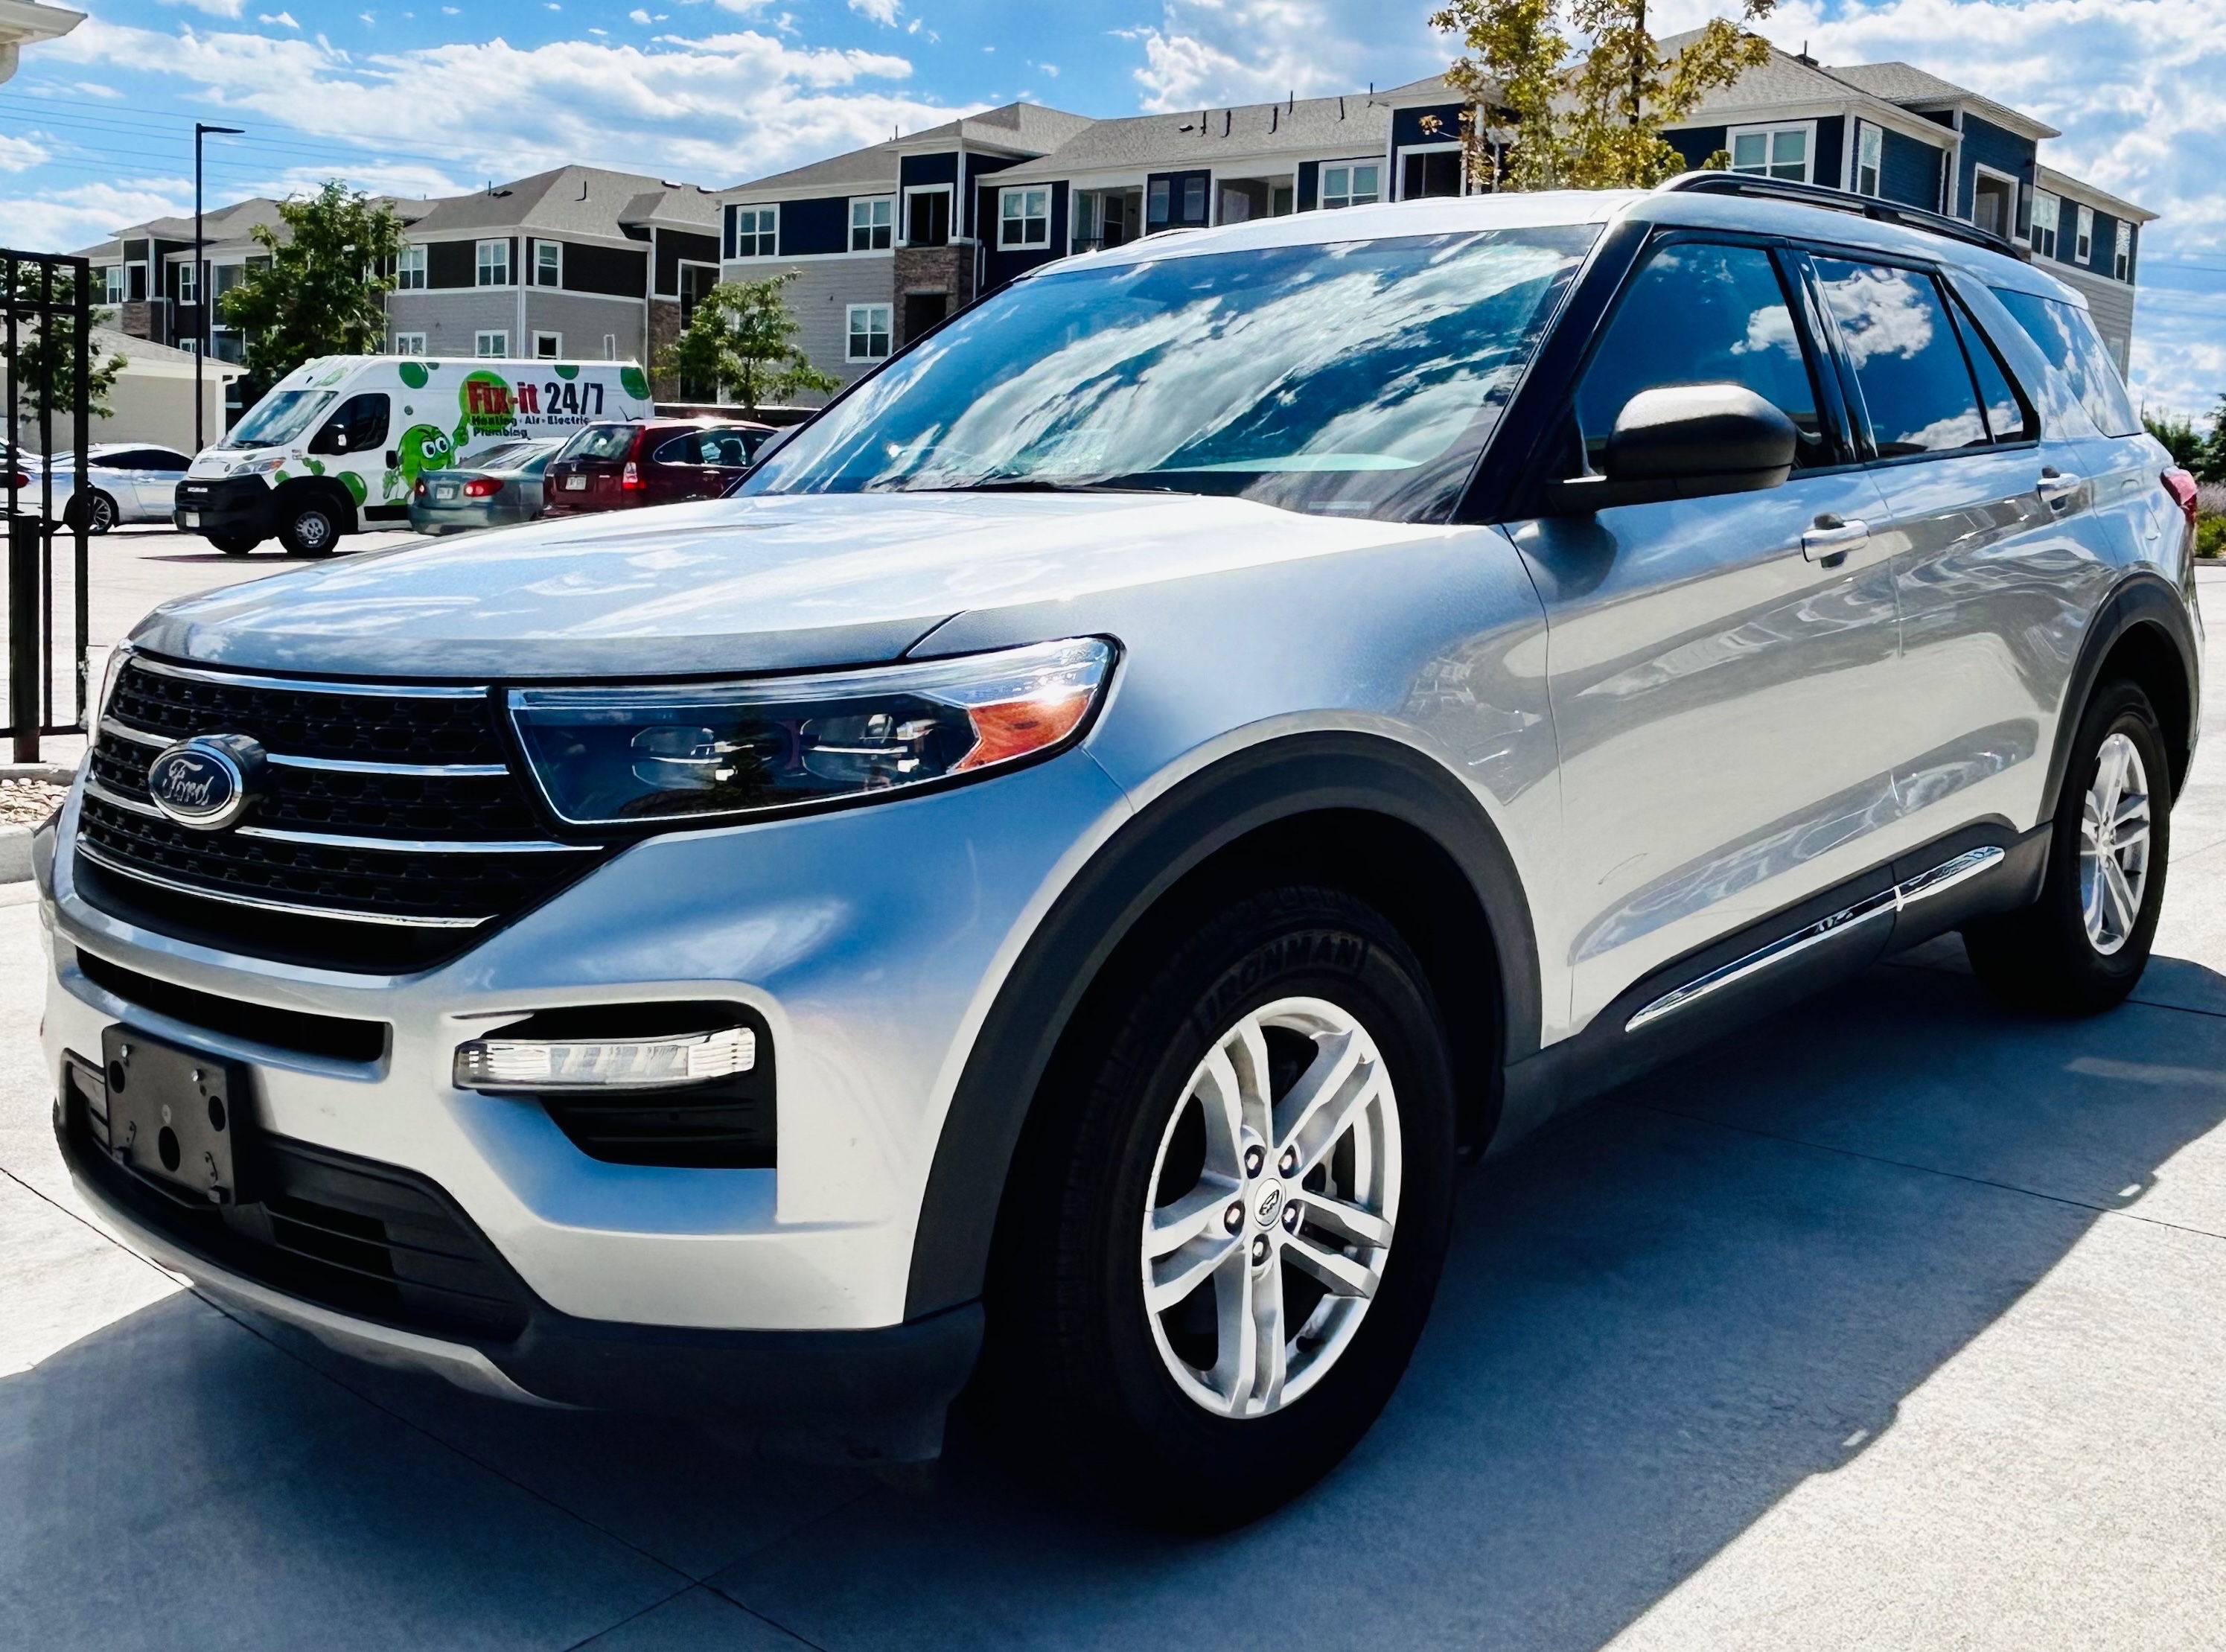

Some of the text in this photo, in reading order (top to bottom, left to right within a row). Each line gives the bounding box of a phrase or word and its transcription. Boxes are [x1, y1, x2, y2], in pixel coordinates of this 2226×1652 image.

[466, 380, 604, 415] Fix-it 24/7
[471, 415, 517, 427] Heating
[524, 415, 540, 425] Air
[162, 759, 214, 806] Ford
[1203, 931, 1364, 1026] IRONMAN
